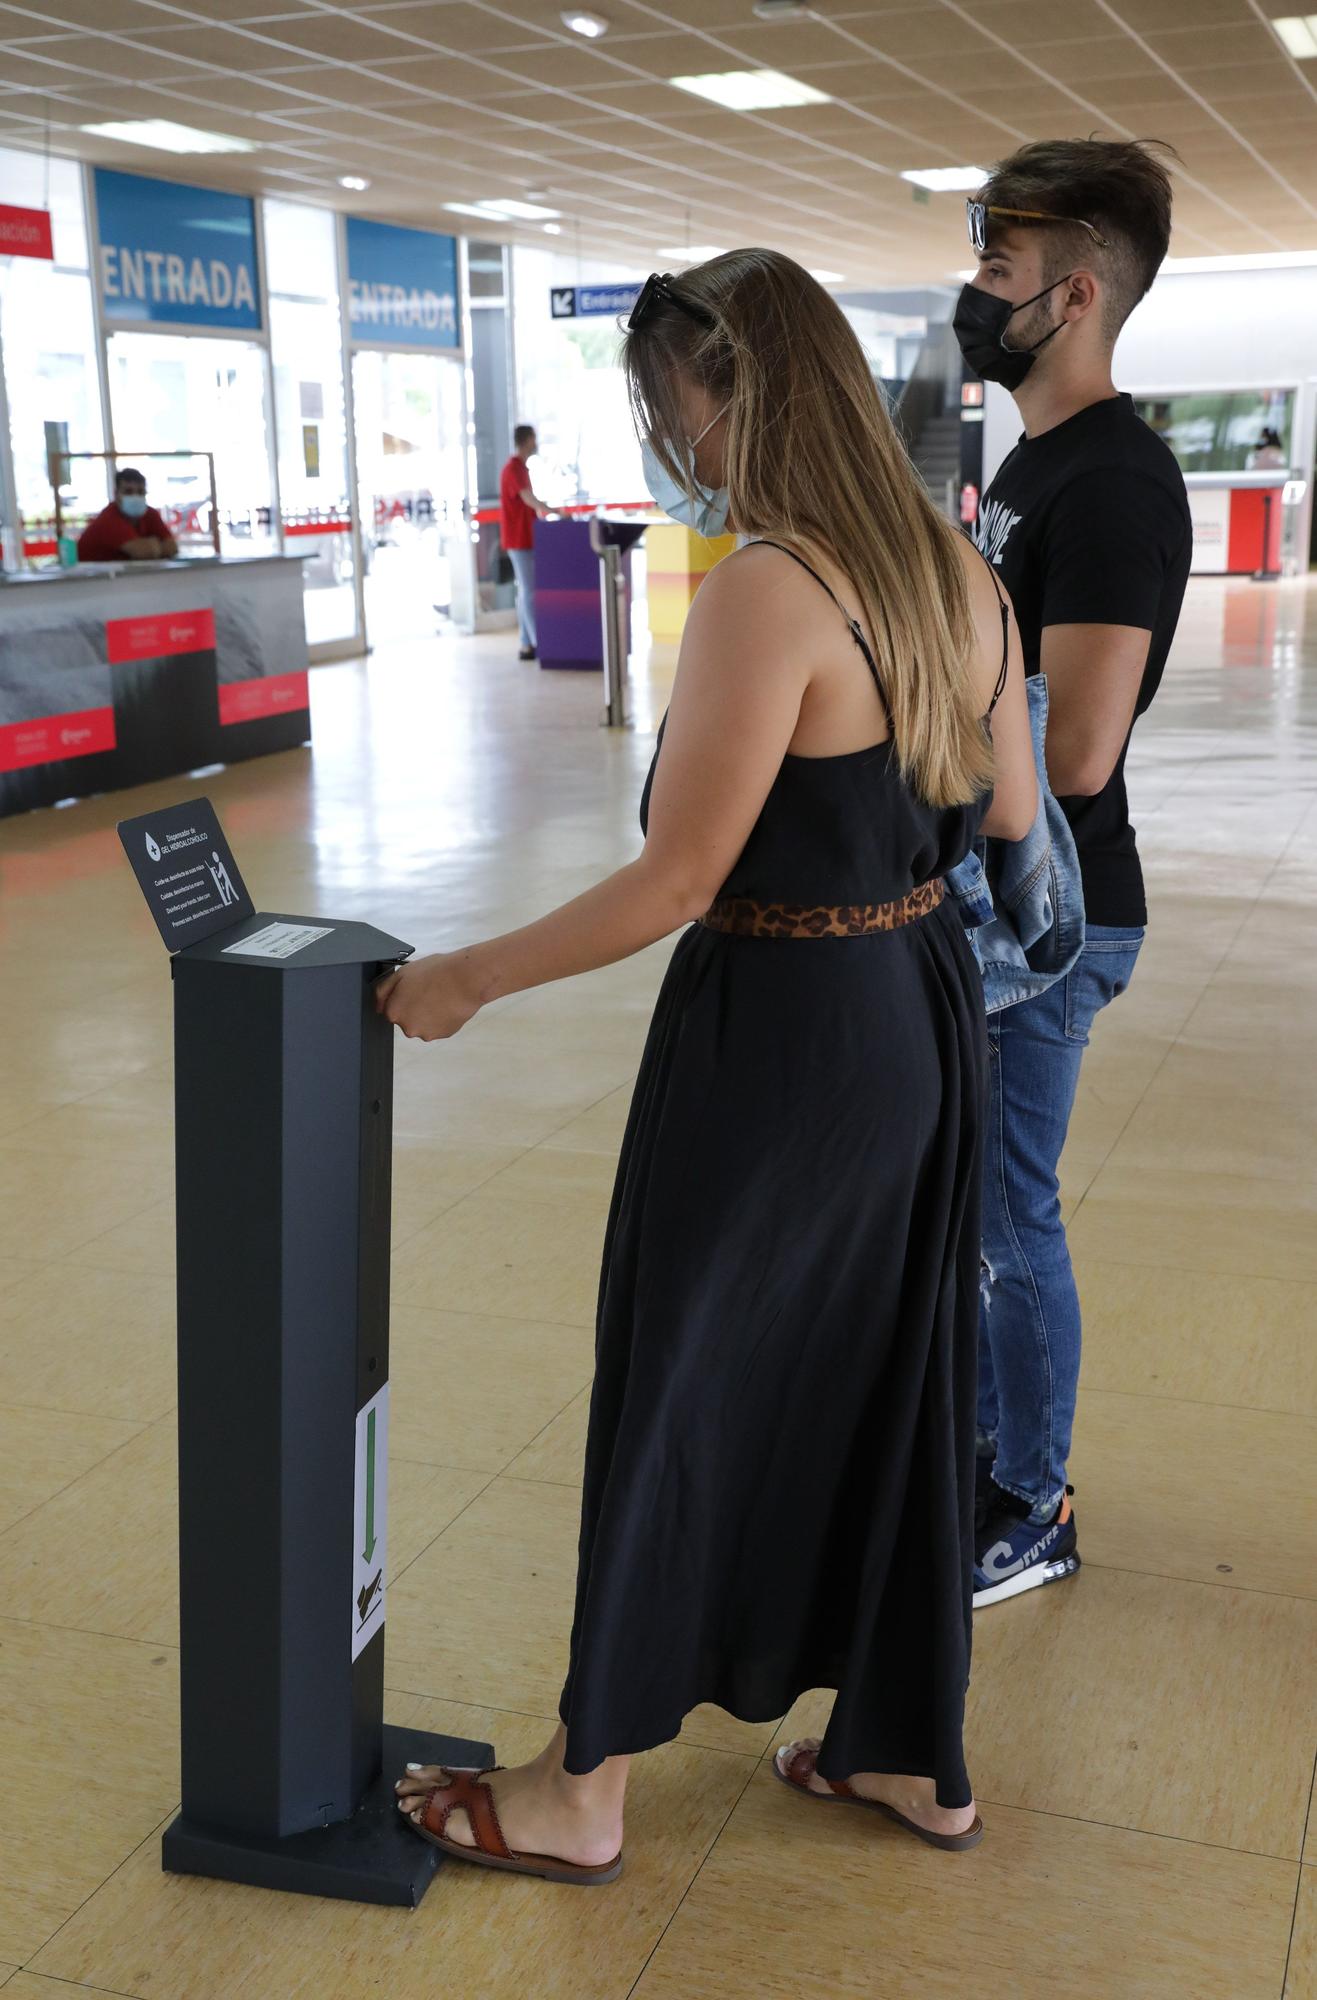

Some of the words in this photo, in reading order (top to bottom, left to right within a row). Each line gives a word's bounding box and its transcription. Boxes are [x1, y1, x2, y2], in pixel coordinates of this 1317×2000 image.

[101, 245, 256, 312] ENTRADA
[349, 281, 456, 333] ENTRADA
[161, 846, 171, 854] GEL
[166, 829, 190, 842] Dispensador
